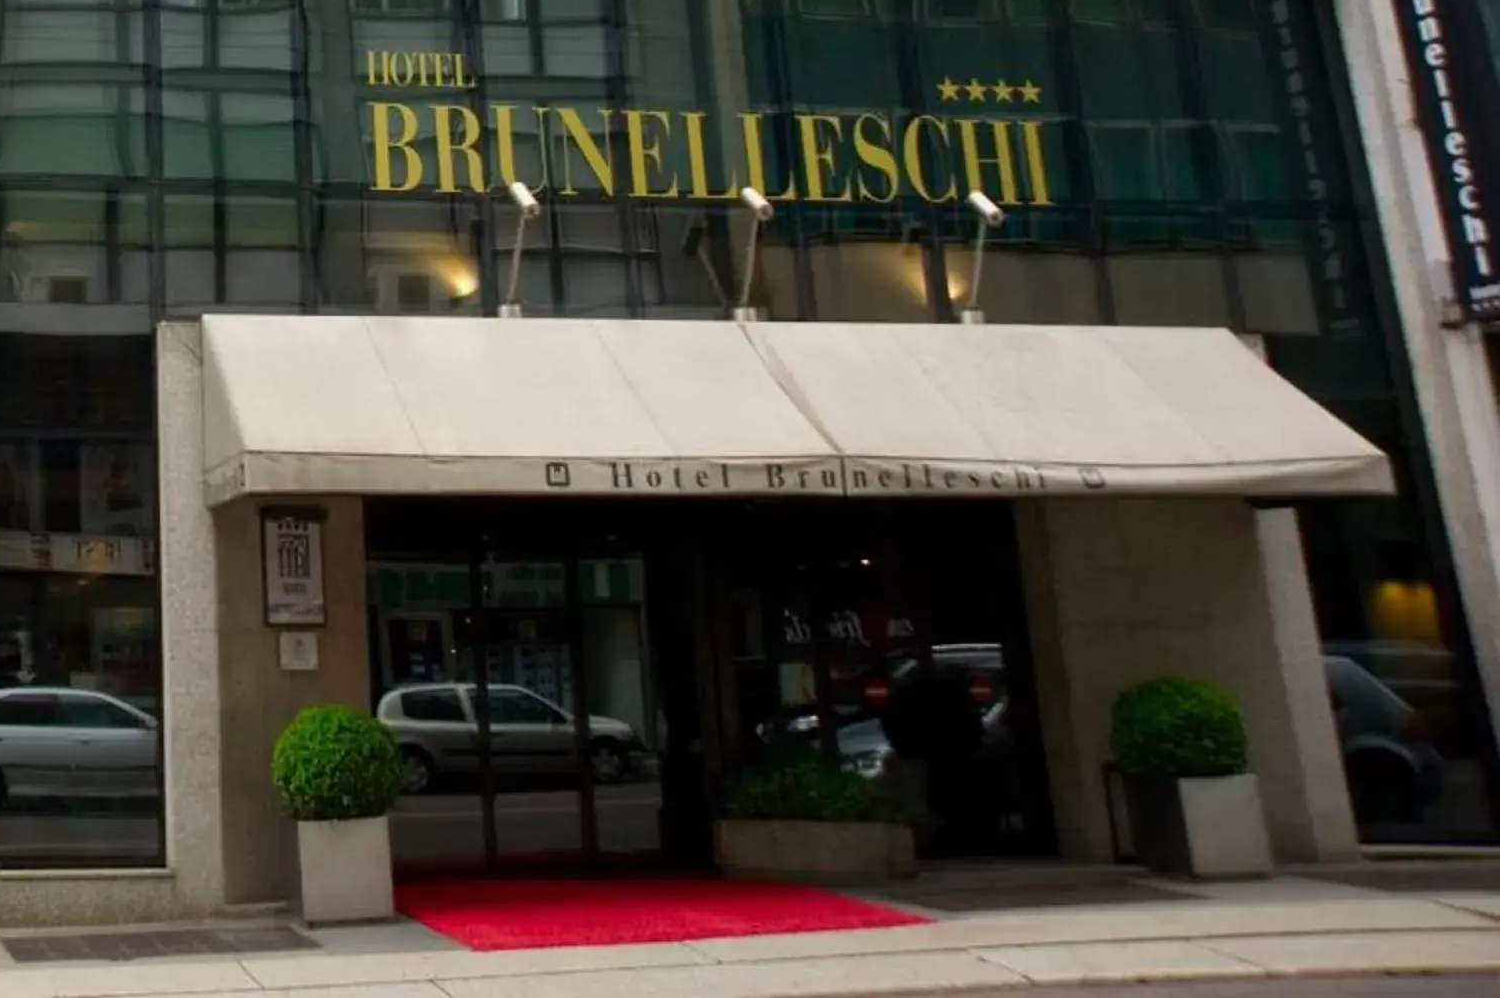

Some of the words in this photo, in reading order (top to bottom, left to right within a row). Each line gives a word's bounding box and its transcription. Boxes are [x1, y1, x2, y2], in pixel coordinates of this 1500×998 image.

[365, 49, 476, 89] HOTEL
[367, 101, 1058, 206] BRUNELLESCHI
[610, 461, 733, 491] Hotel
[766, 462, 1050, 492] Brunelleschi
